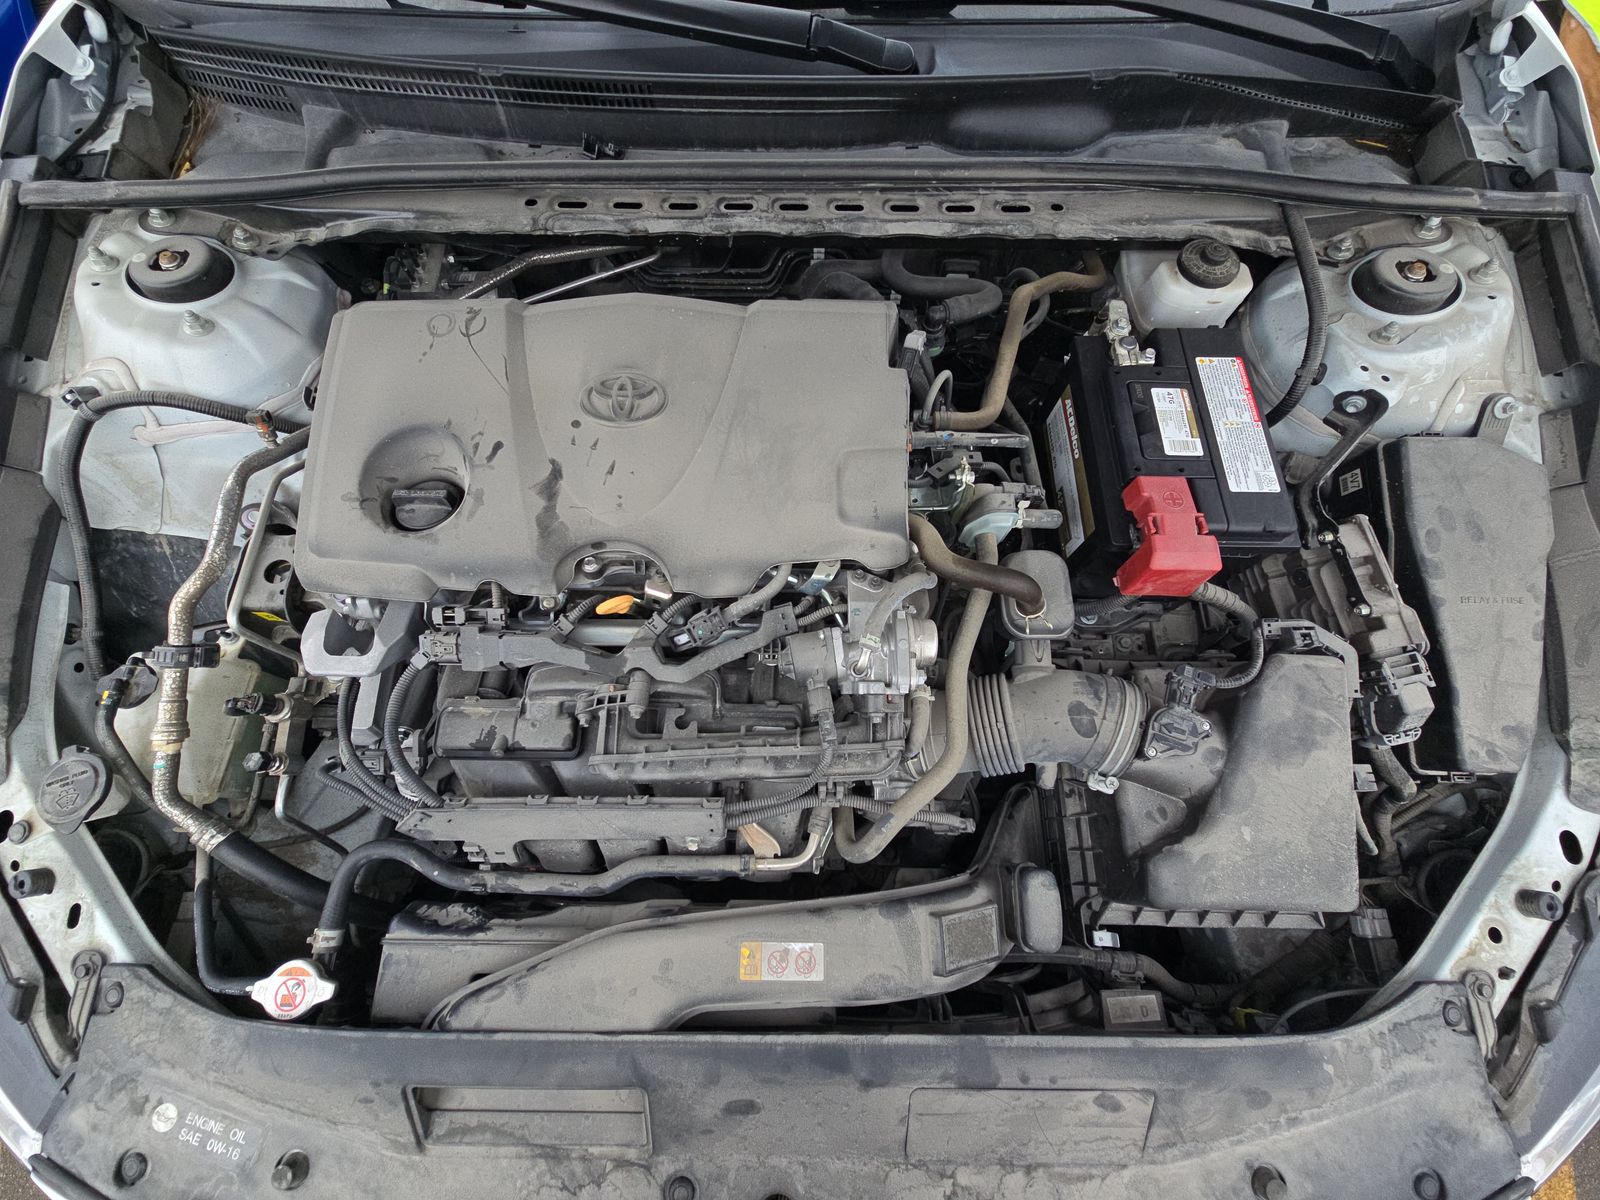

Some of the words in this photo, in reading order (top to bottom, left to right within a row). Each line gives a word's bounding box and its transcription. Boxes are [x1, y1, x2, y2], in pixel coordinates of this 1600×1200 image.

[1167, 391, 1175, 404] 47G
[1065, 399, 1080, 460] ACDelco
[1349, 472, 1361, 489] AV7
[1460, 596, 1490, 605] RELAY
[1501, 596, 1525, 605] FUSE
[185, 1111, 225, 1136] ENGINE
[229, 1128, 247, 1145] OIL
[178, 1127, 202, 1146] SAE
[206, 1138, 241, 1160] 0W-16
